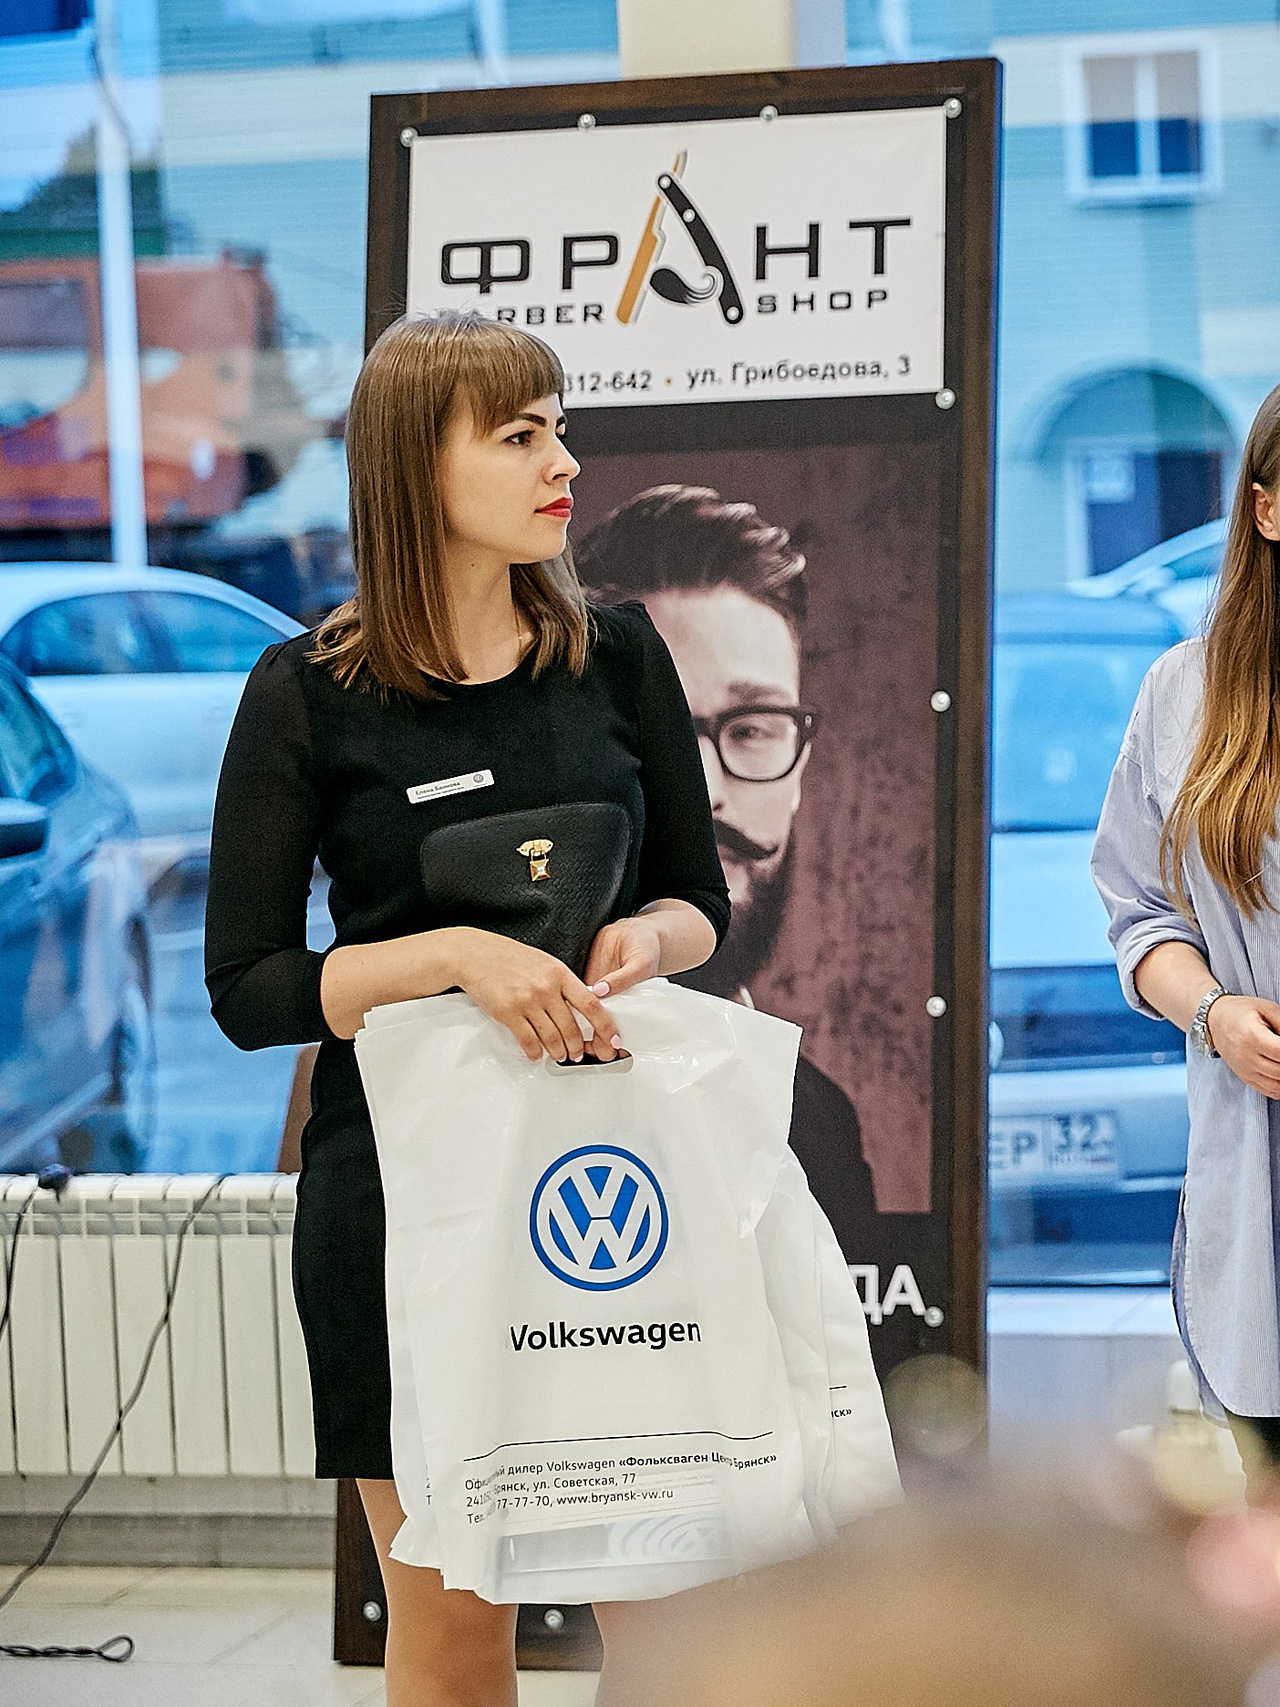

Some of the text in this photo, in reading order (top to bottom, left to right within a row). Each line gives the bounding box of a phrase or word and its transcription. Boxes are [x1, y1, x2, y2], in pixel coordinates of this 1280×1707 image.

[440, 149, 911, 323] ФРАНТ
[757, 288, 888, 315] SHOP
[686, 367, 722, 392] ул.
[731, 358, 890, 387] Грибоедова,
[898, 353, 910, 375] 3
[510, 1321, 702, 1351] Volkswagen
[507, 1465, 544, 1476] дилер
[547, 1459, 616, 1474] Volkswagen
[618, 1453, 708, 1468] «Фольксваген
[533, 1481, 550, 1493] ул.
[553, 1477, 618, 1490] Советская,
[622, 1473, 636, 1484] 77
[556, 1490, 674, 1506] www.bryansk-vw.ru
